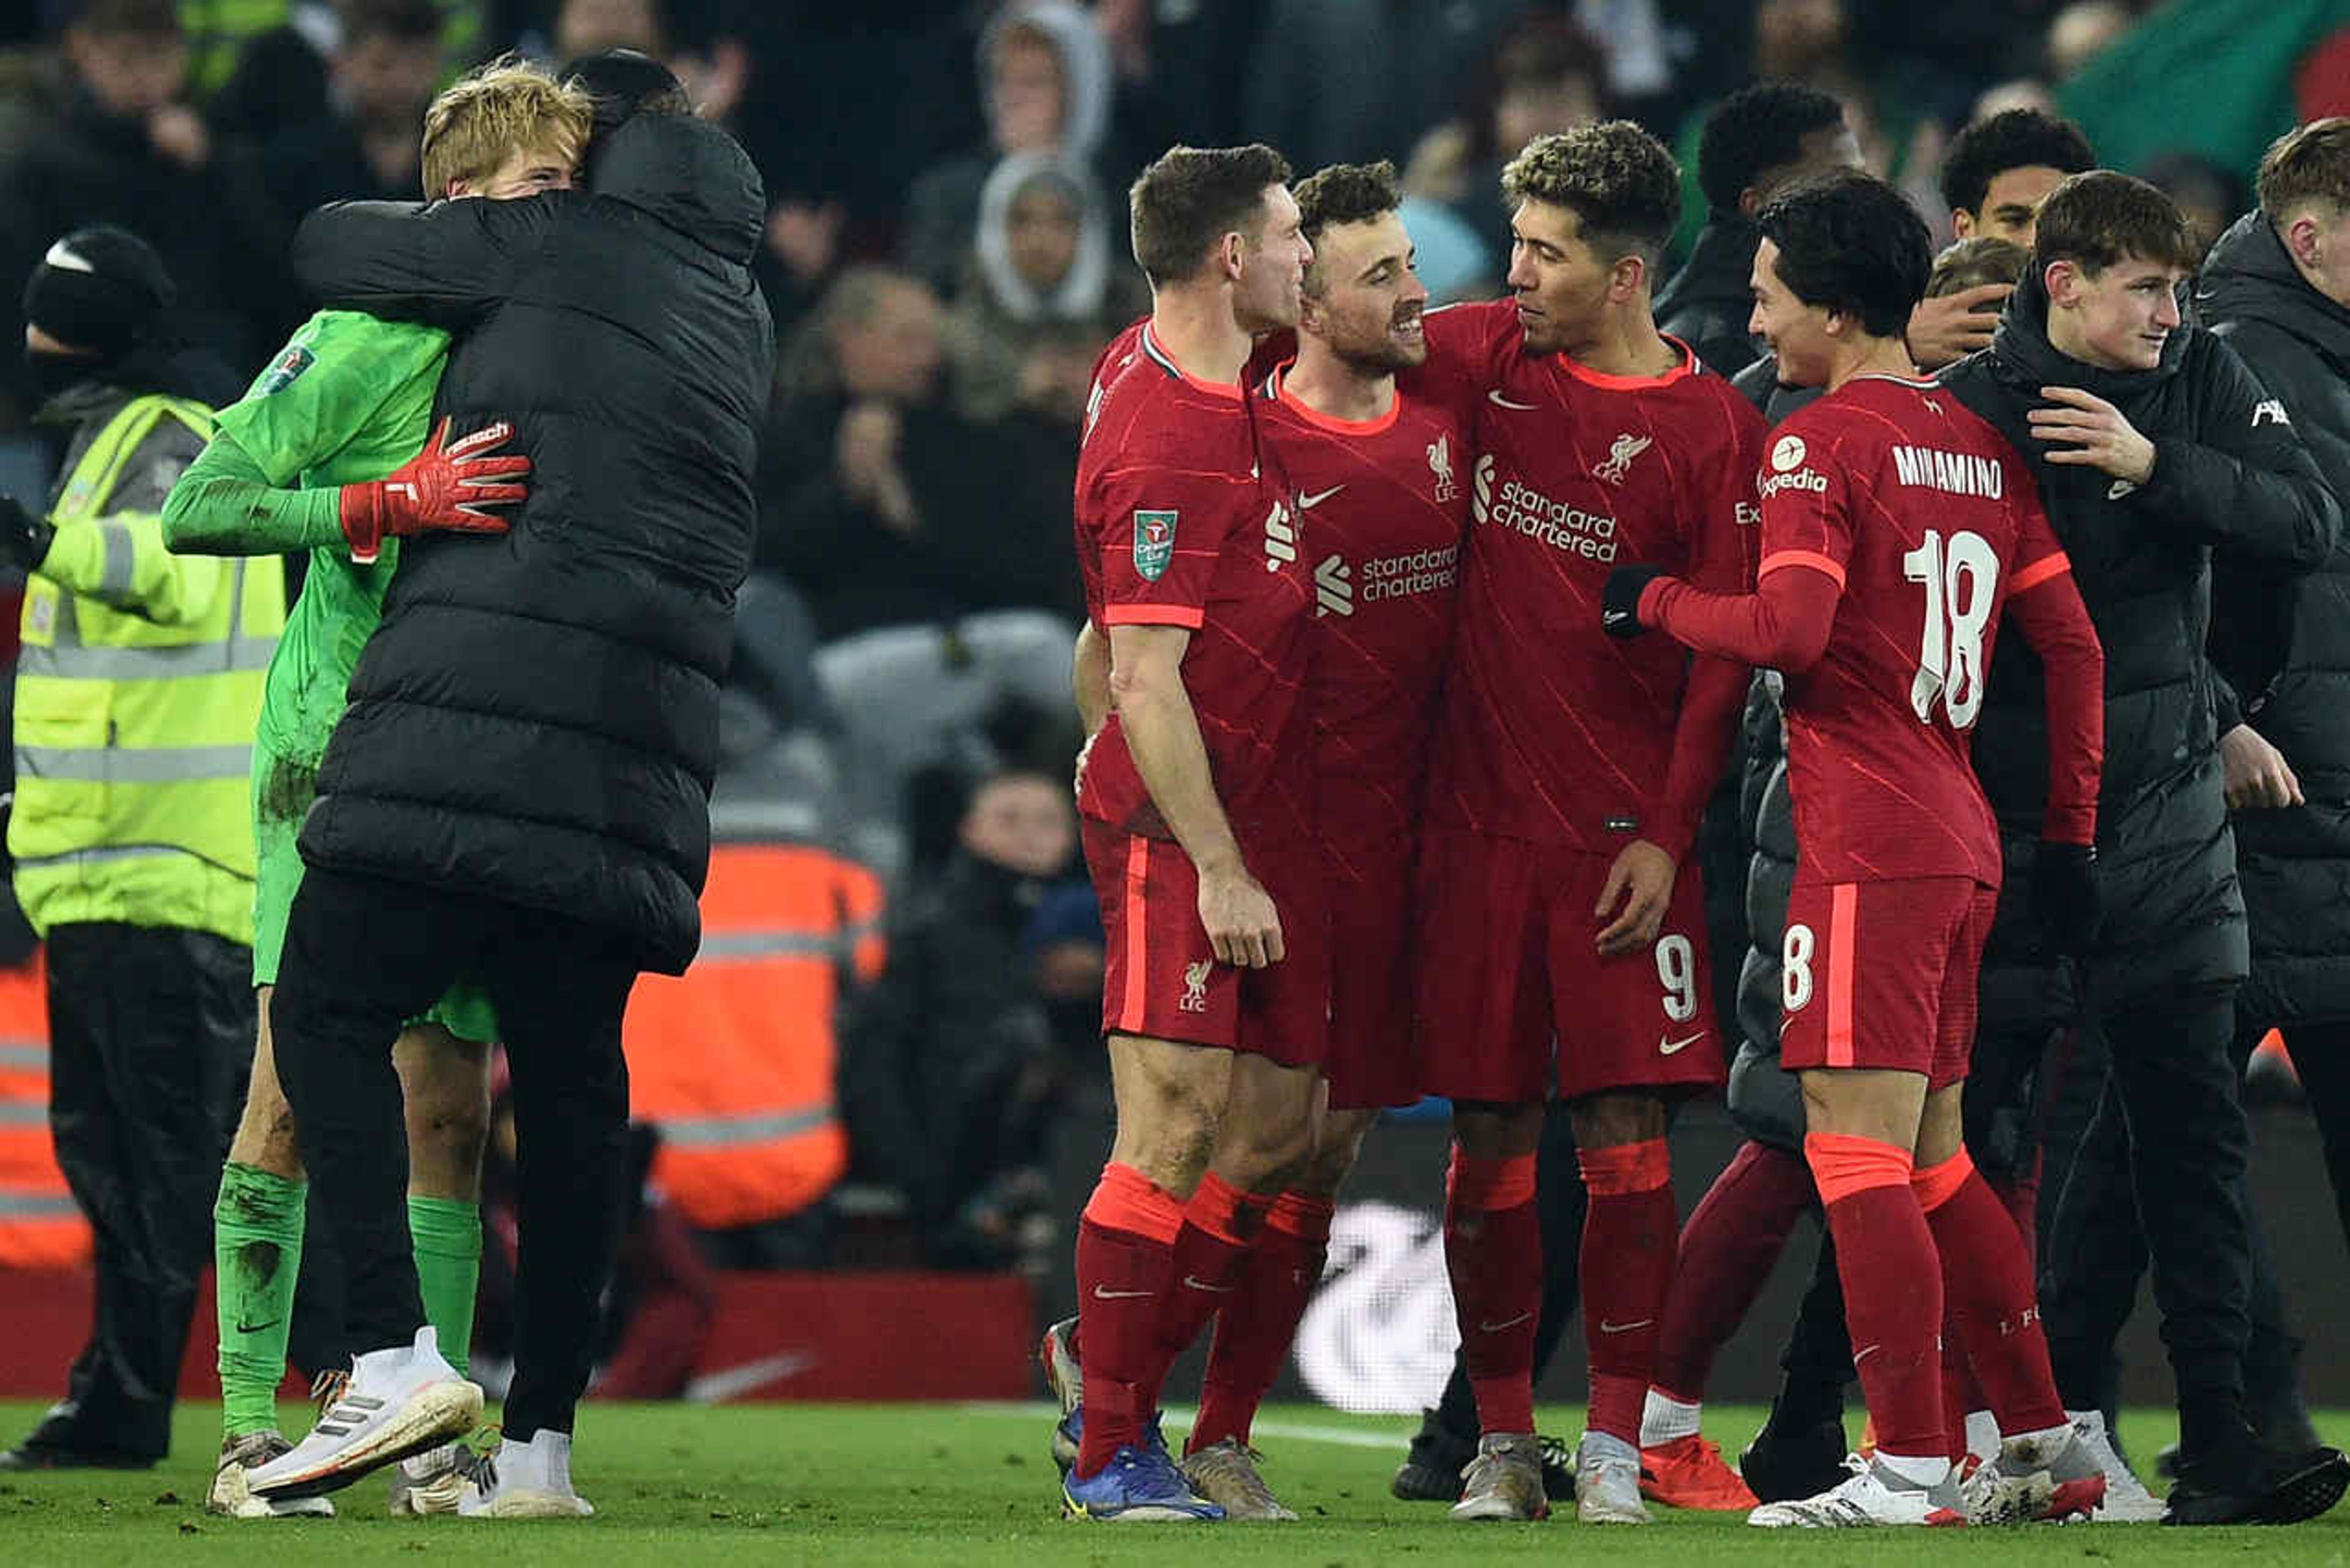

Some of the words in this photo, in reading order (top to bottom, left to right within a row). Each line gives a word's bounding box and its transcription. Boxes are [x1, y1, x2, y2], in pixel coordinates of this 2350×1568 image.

[1892, 446, 2002, 499] MINAMINO
[1493, 504, 1617, 562] chartered
[1500, 482, 1616, 539] standard
[1363, 548, 1457, 581] standard
[1903, 529, 1999, 728] 18
[1655, 935, 1696, 1023] 9
[1783, 924, 1815, 1011] 8
